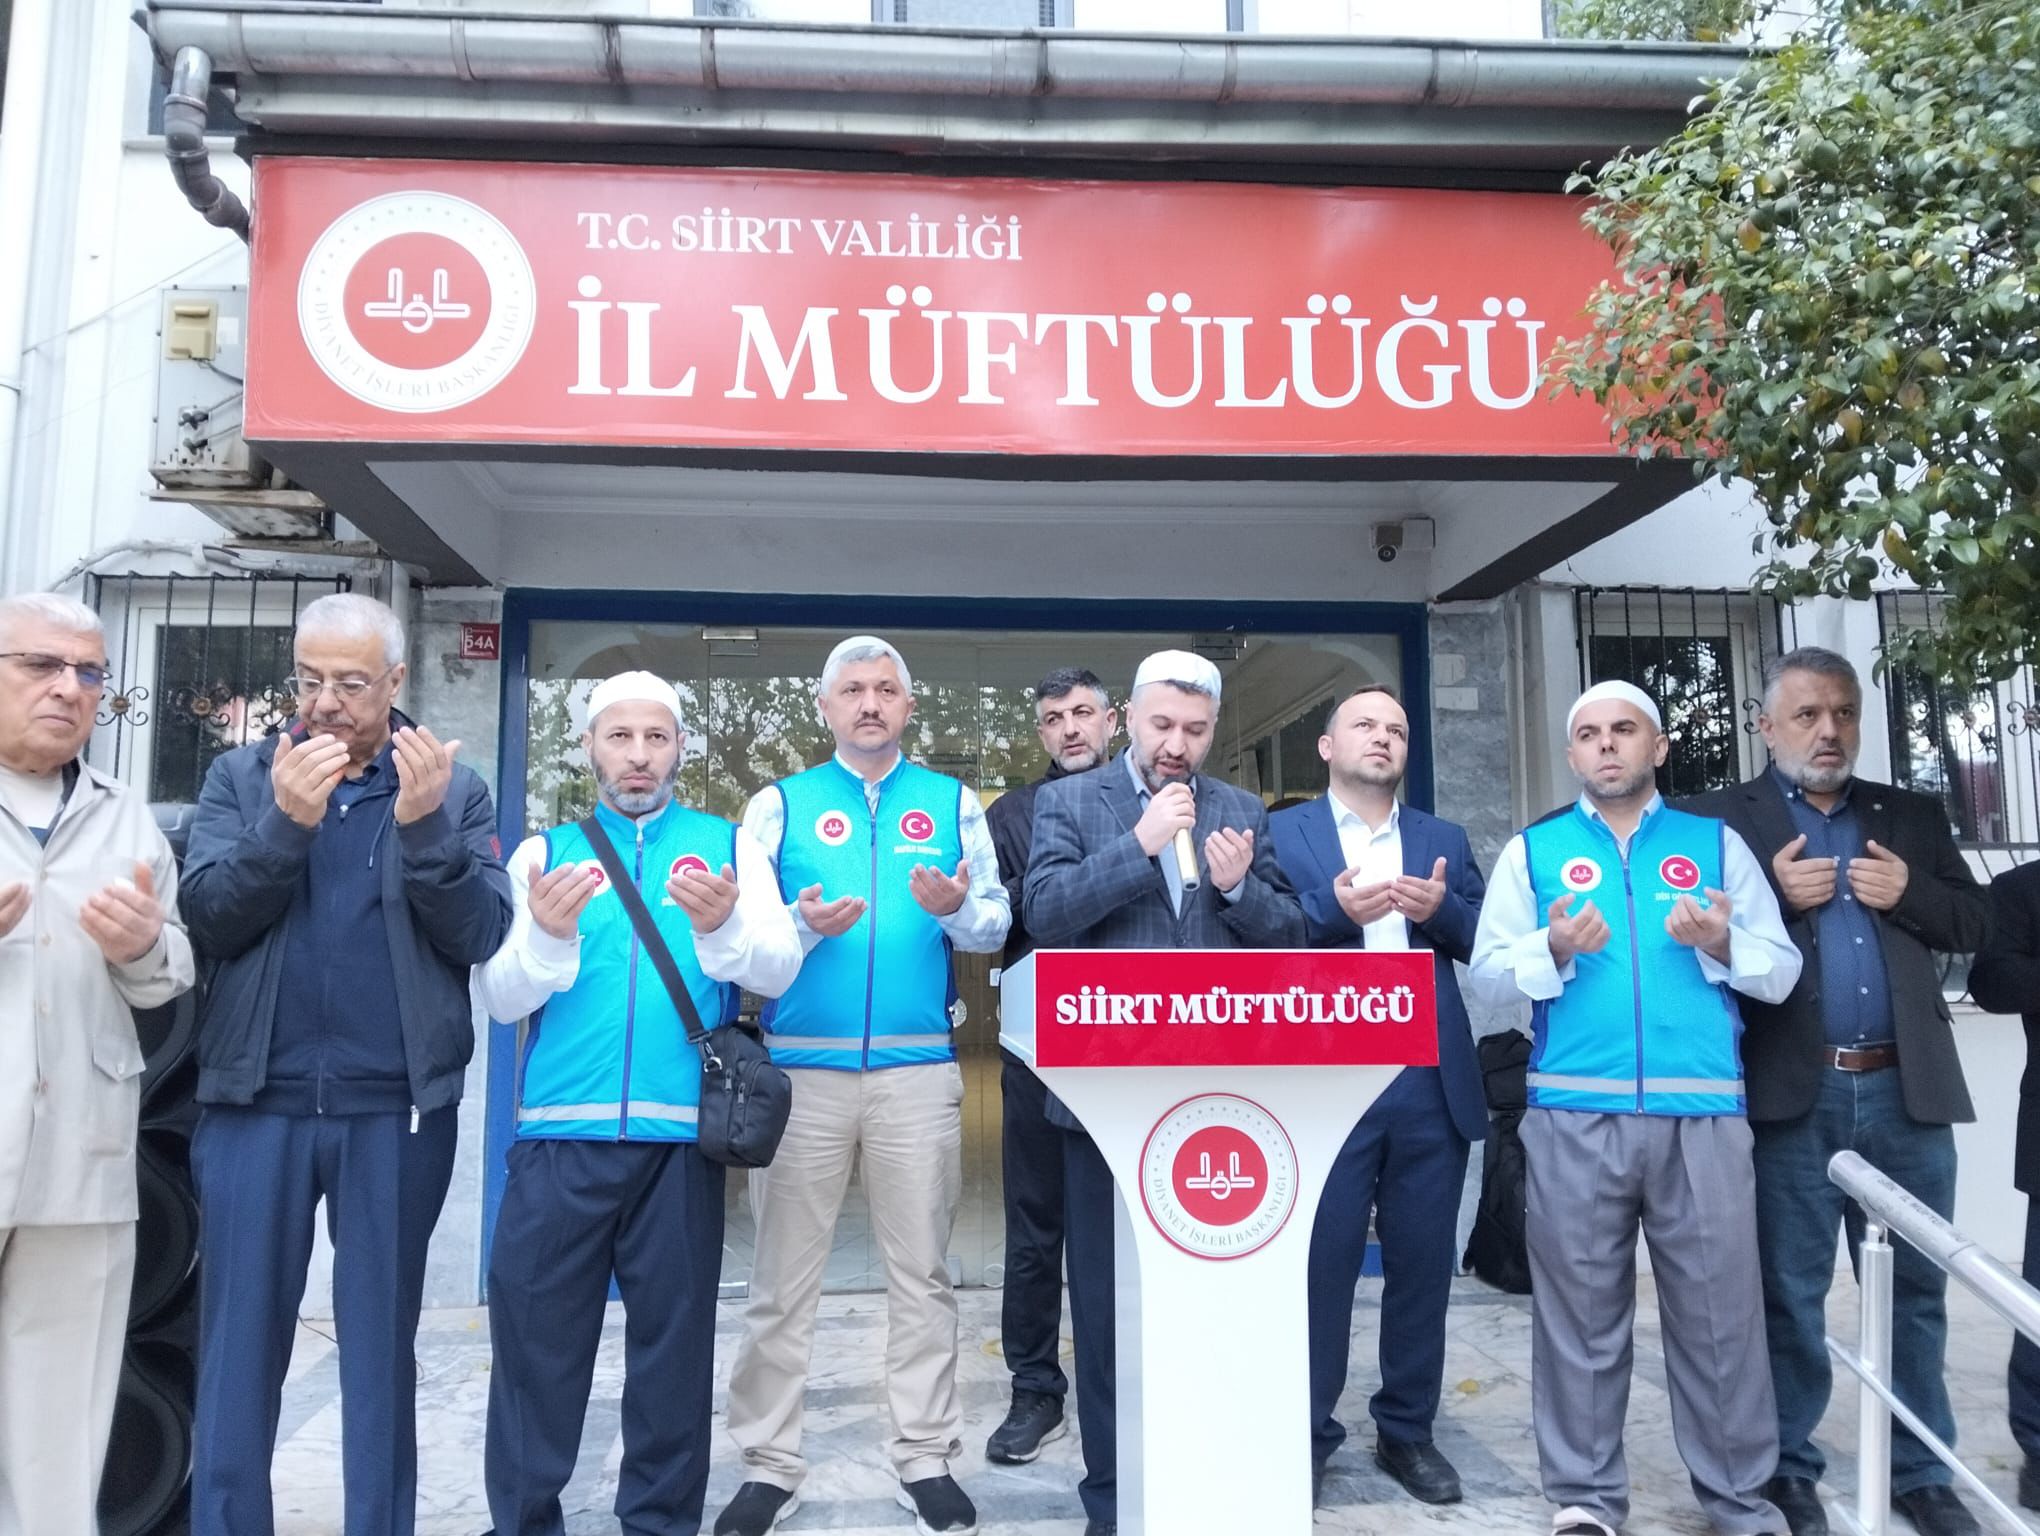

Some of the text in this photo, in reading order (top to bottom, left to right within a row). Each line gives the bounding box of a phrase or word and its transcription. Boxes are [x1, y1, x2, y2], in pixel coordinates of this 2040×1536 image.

[577, 206, 1023, 262] T.C. SİİRT VALİLİĞİ
[567, 275, 1546, 410] İL MÜFTÜLÜĞÜ
[1055, 985, 1415, 1025] SİİRT MÜFTÜLÜĞÜ
[1153, 1178, 1189, 1232] DİYANET
